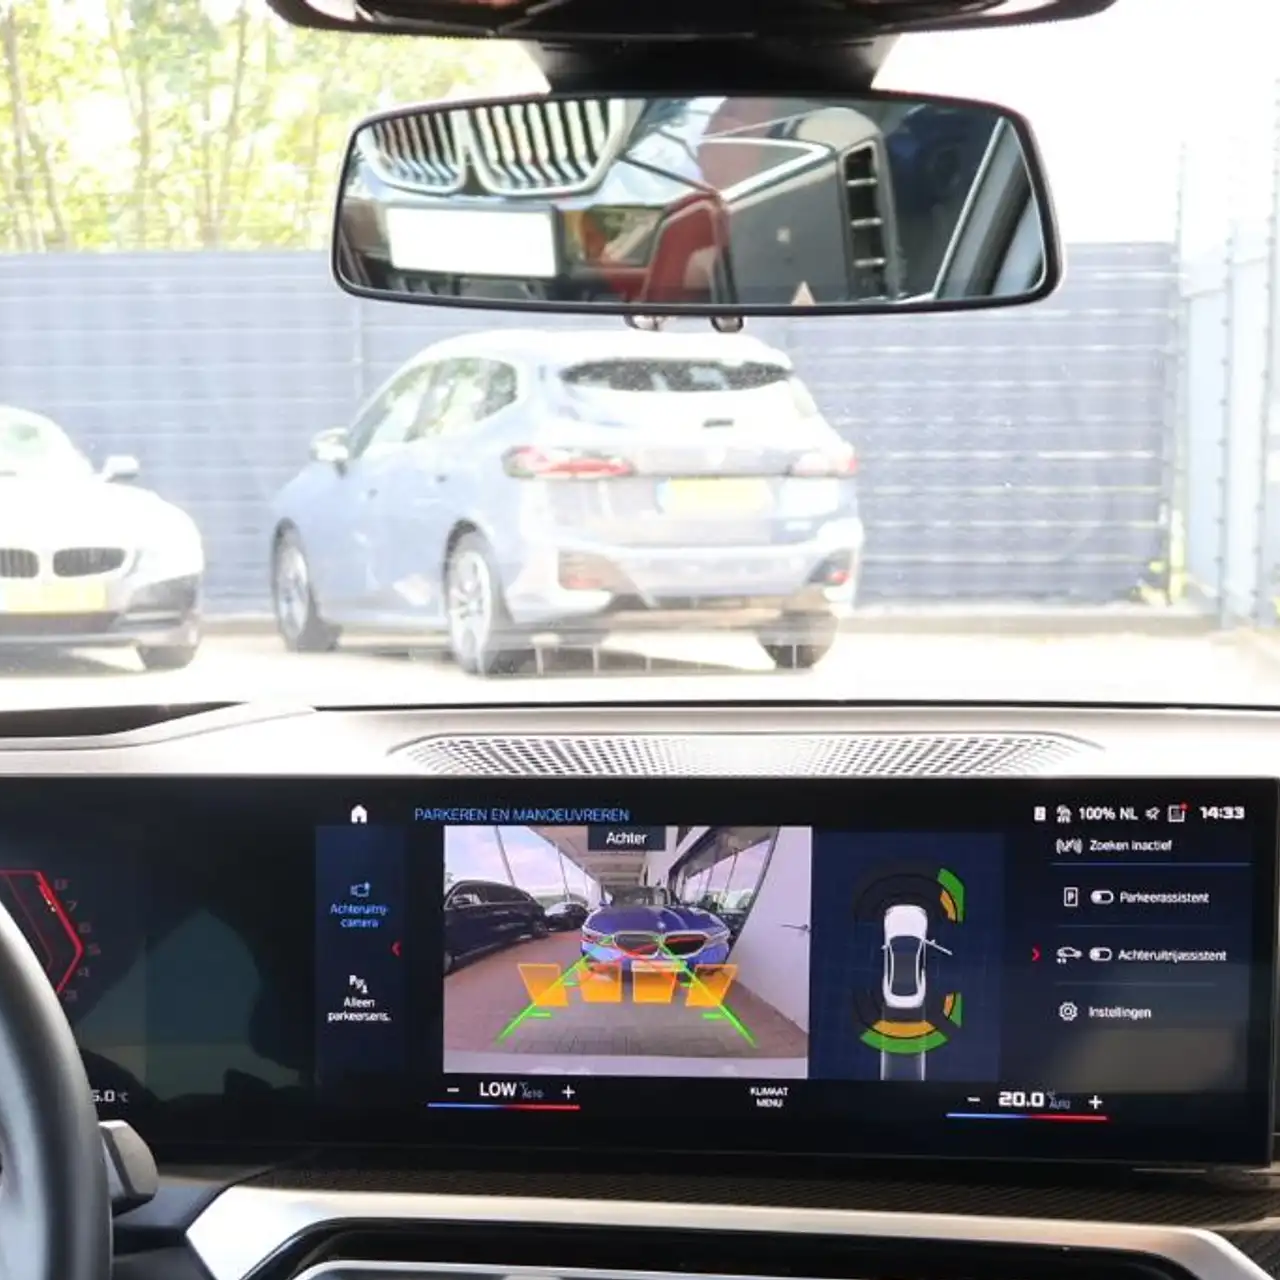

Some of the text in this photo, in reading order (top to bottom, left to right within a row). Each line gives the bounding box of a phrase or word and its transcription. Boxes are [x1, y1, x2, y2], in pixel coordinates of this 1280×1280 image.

[415, 808, 630, 822] PARKEREN EN MANOEUVREREN
[1079, 807, 1138, 820] 100% NL
[1200, 806, 1245, 820] 14:33
[606, 831, 647, 845] Achter
[1089, 839, 1172, 852] Zoeken inactief
[1120, 891, 1210, 903] Parkeerassistent
[340, 919, 380, 928] camera
[1118, 949, 1227, 964] Achteruitrijassistent
[343, 996, 376, 1008] Alleen
[1088, 1006, 1152, 1020] Instellingen
[479, 1082, 517, 1097] LOW
[750, 1086, 789, 1096] KLIMAAT
[998, 1090, 1044, 1107] 20.0
